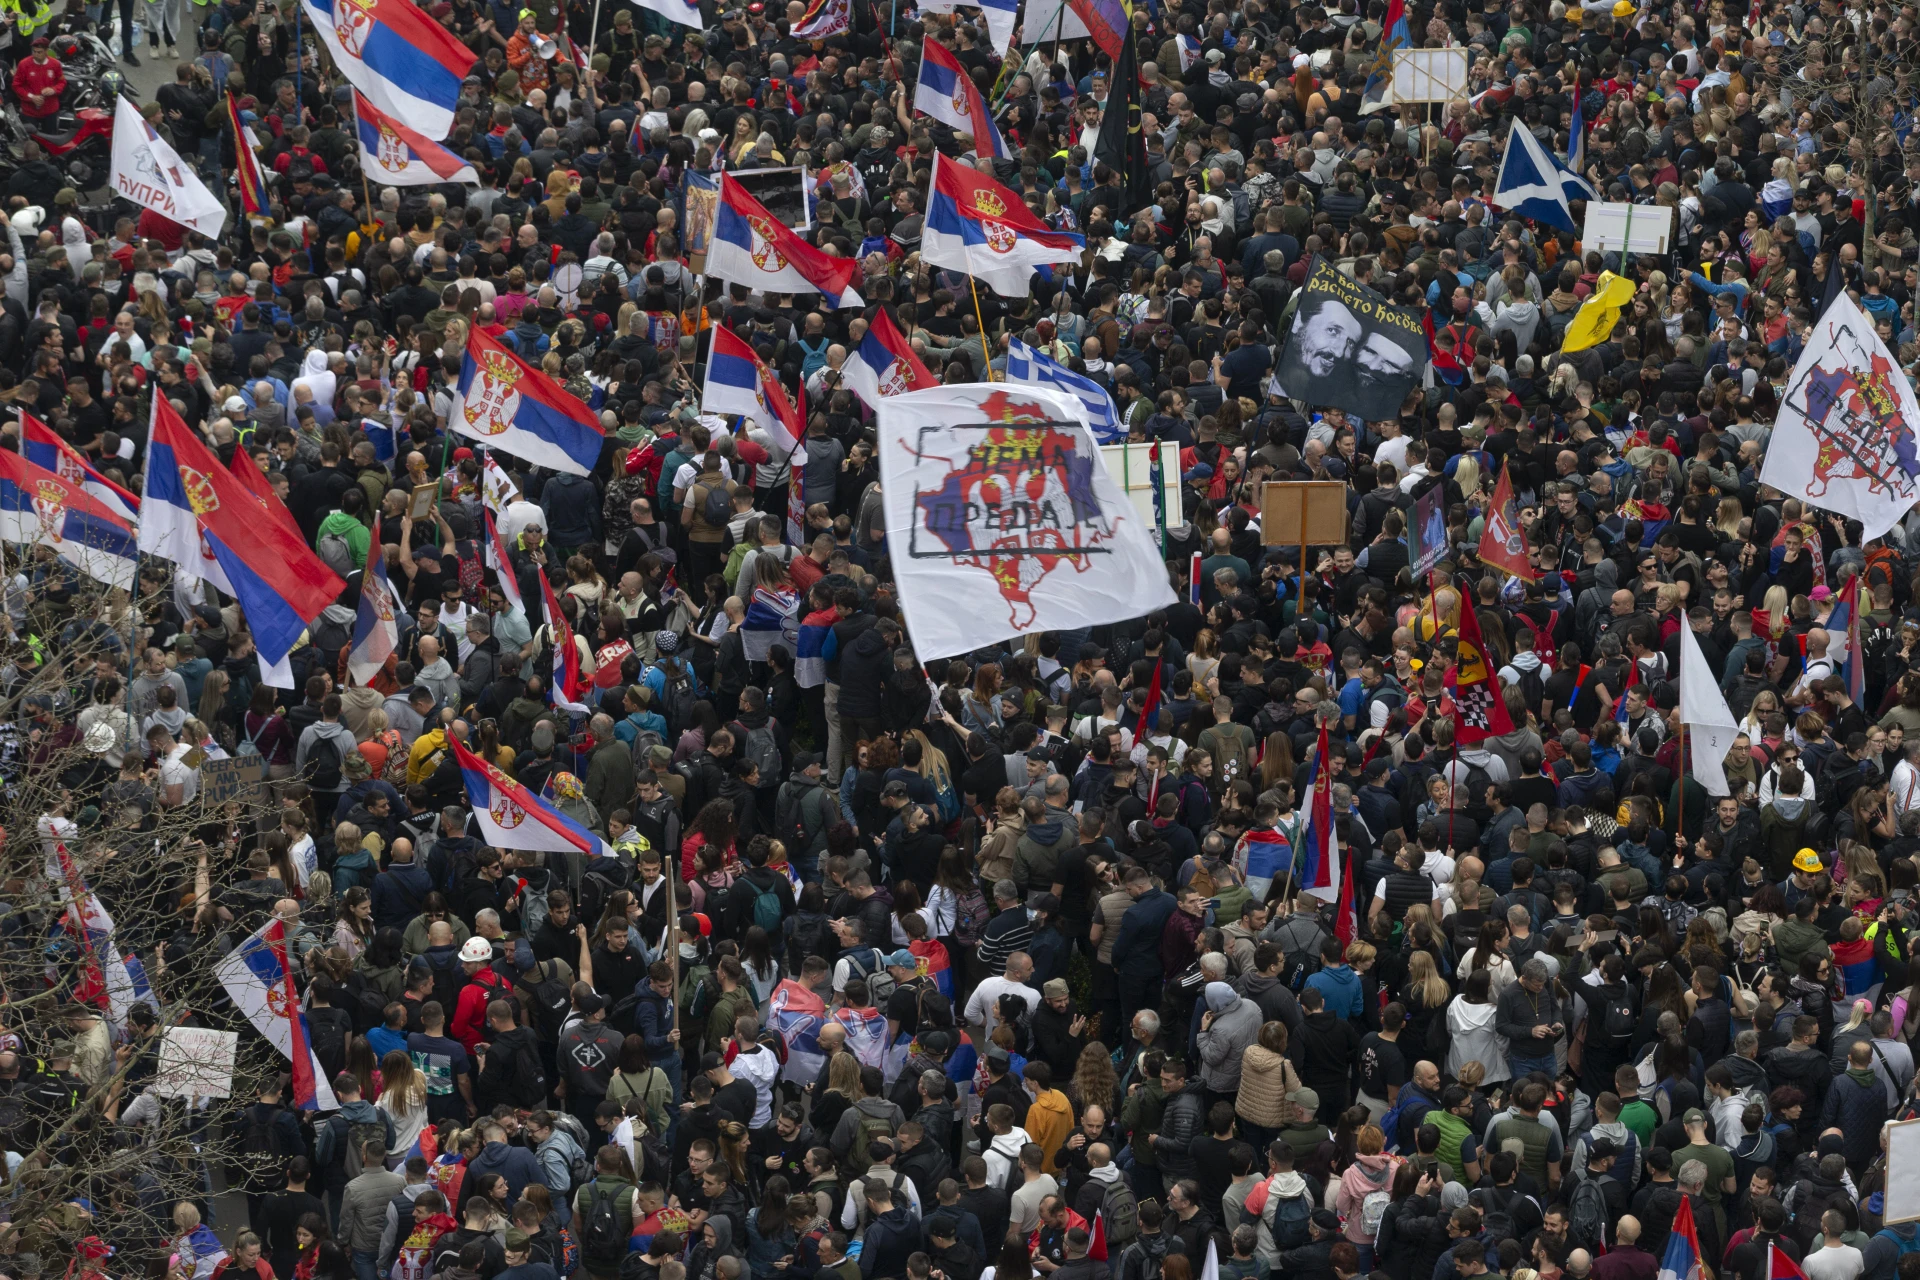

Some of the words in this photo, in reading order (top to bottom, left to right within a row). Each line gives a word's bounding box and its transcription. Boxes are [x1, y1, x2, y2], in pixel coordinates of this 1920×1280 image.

[118, 172, 198, 228] ЋУПРИА
[201, 758, 232, 774] KEEP
[234, 755, 262, 769] CALM
[215, 770, 241, 785] AND
